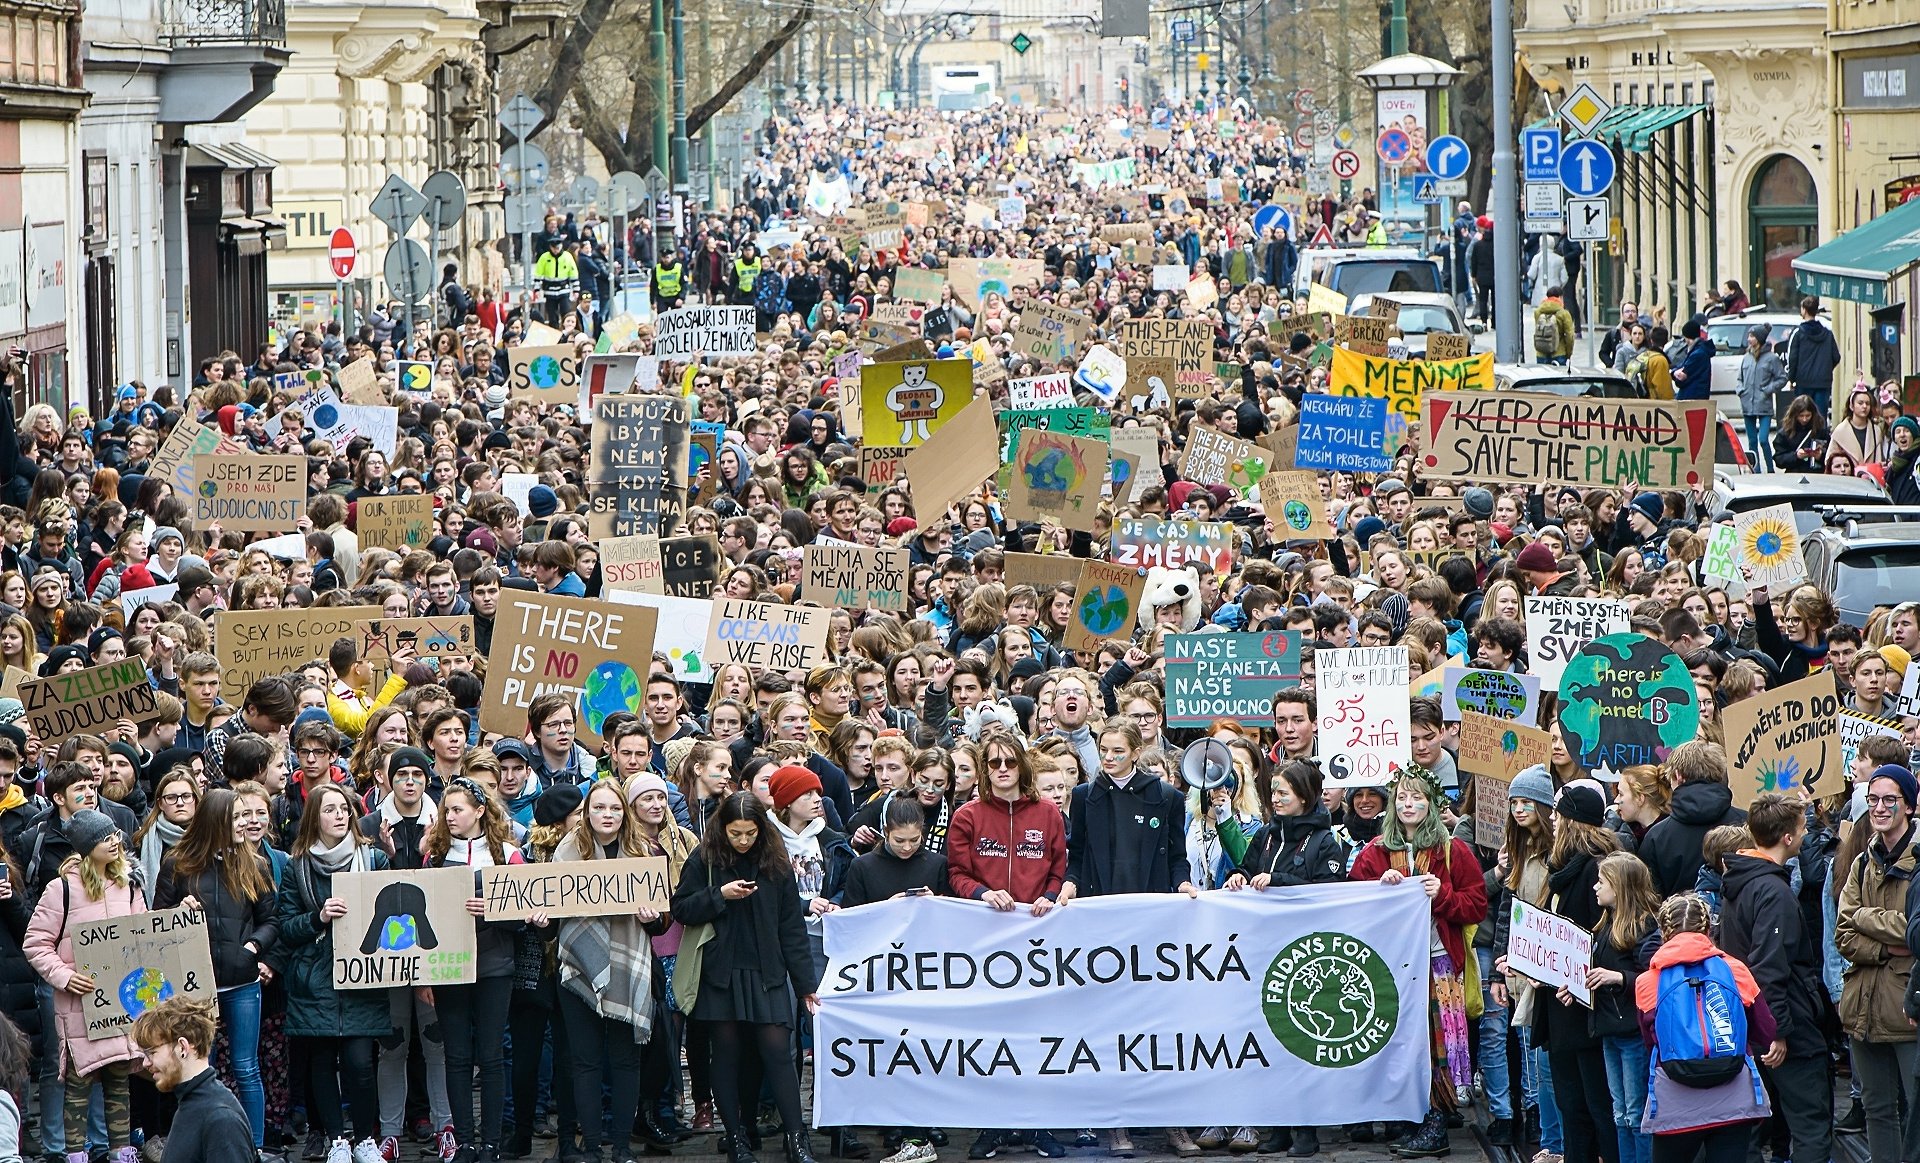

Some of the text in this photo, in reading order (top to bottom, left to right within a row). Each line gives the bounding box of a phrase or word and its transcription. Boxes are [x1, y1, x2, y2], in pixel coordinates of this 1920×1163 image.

[1753, 71, 1791, 81] OLYMPIA
[1532, 136, 1552, 165] P
[281, 212, 332, 236] TIL
[876, 307, 908, 318] MAKE
[1026, 300, 1080, 326] What I stand
[1373, 296, 1398, 311] THERE
[1377, 308, 1388, 317] IS
[660, 307, 716, 333] DINOSAUŘI
[718, 308, 729, 326] SI
[1040, 317, 1064, 333] FOR
[659, 333, 701, 353] MYSLELI
[702, 326, 720, 352] ŽE
[721, 327, 739, 352] MAJÍ
[1046, 331, 1051, 340] I
[1127, 321, 1213, 341] THIS PLANET
[1436, 335, 1463, 347] STÁLE
[1886, 328, 1896, 341] P
[1031, 340, 1052, 357] ON
[1125, 340, 1206, 358] IS GETTING
[1432, 345, 1463, 358] JE ČAS
[276, 373, 305, 389] Tohle
[1365, 358, 1483, 395] MĚŇME
[899, 392, 932, 400] GLOBAL
[1034, 379, 1068, 399] MEAN
[303, 389, 329, 416] SAVE
[602, 401, 685, 424] NEMŮŽU
[1303, 396, 1354, 415] NECHÁPU
[1358, 399, 1375, 418] ŽE
[900, 410, 934, 418] WARMING
[1454, 398, 1532, 434] KEEP
[1537, 403, 1606, 441] CALM
[1612, 406, 1678, 446] AND
[325, 423, 348, 440] THE
[1194, 426, 1249, 457] THE TEA IS
[1301, 424, 1322, 441] ZA
[1325, 426, 1382, 449] TOHLE
[611, 444, 668, 465] NĚMÝ
[1191, 445, 1226, 466] HOT AND
[1298, 446, 1332, 465] MUSÍM
[1336, 452, 1394, 470] PROTESTOVAT
[1452, 437, 1685, 487] SAVE THE PLANET
[207, 463, 297, 482] JSEM ZDE
[1187, 455, 1226, 478] SO IS OUR
[227, 482, 276, 493] PRO NAŠI
[618, 472, 670, 491] KDYŽ
[198, 498, 300, 521] BUDOUCNOST
[365, 499, 423, 517] OUR FUTURE
[594, 497, 681, 517] SE KLIMA
[384, 516, 406, 526] IS IN
[617, 516, 665, 538] MĚNÍ
[1122, 521, 1221, 539] JE ČAS NA
[1737, 510, 1789, 529] THERE IS NO
[362, 527, 430, 547] YOUR HANDS
[811, 549, 897, 573] KLIMA SE
[1119, 540, 1222, 571] ZMĚNY
[811, 568, 904, 593] MĚNÍ, PROČ
[1088, 566, 1136, 587] DOCHÁZÍ
[724, 602, 811, 625] LIKE THE
[1529, 598, 1630, 622] ZMĚŇ SYSTÉM
[233, 619, 352, 646] SEX IS GOOD
[514, 601, 623, 650] THERE
[717, 619, 800, 644] OCEANS
[233, 643, 323, 664] BUT HAVE U
[727, 640, 814, 669] WE RISE
[1175, 637, 1237, 658] NAŠE
[511, 643, 579, 680] IS NO
[1197, 660, 1282, 677] PLANETA
[21, 659, 147, 711] ZA ZELENOU
[1175, 677, 1232, 696] NAŠE
[1323, 666, 1410, 689] FOR OUR FUTURE
[1466, 680, 1519, 693] DENYING
[1478, 673, 1504, 682] STOP
[1470, 690, 1523, 701] THE EARTH
[1485, 698, 1494, 706] IS
[1612, 685, 1633, 699] no
[1734, 695, 1836, 770] VEZMĚME TO DO
[1775, 715, 1836, 752] VLASTNÍCH
[488, 870, 669, 914] #AKCEPROKLIMA
[79, 925, 120, 946] SAVE
[152, 909, 206, 934] PLANET
[428, 952, 472, 966] GREEN
[834, 933, 1251, 993] STŘEDOŠKOLSKÁ
[1265, 935, 1373, 1003] FRIDAYS FOR
[336, 955, 420, 985] JOIN THE
[430, 966, 463, 981] SIDE
[89, 1013, 134, 1031] ANIMALS
[1315, 1017, 1391, 1063] FUTURE
[831, 1028, 1270, 1078] STÁVKA ZA KLIMA
